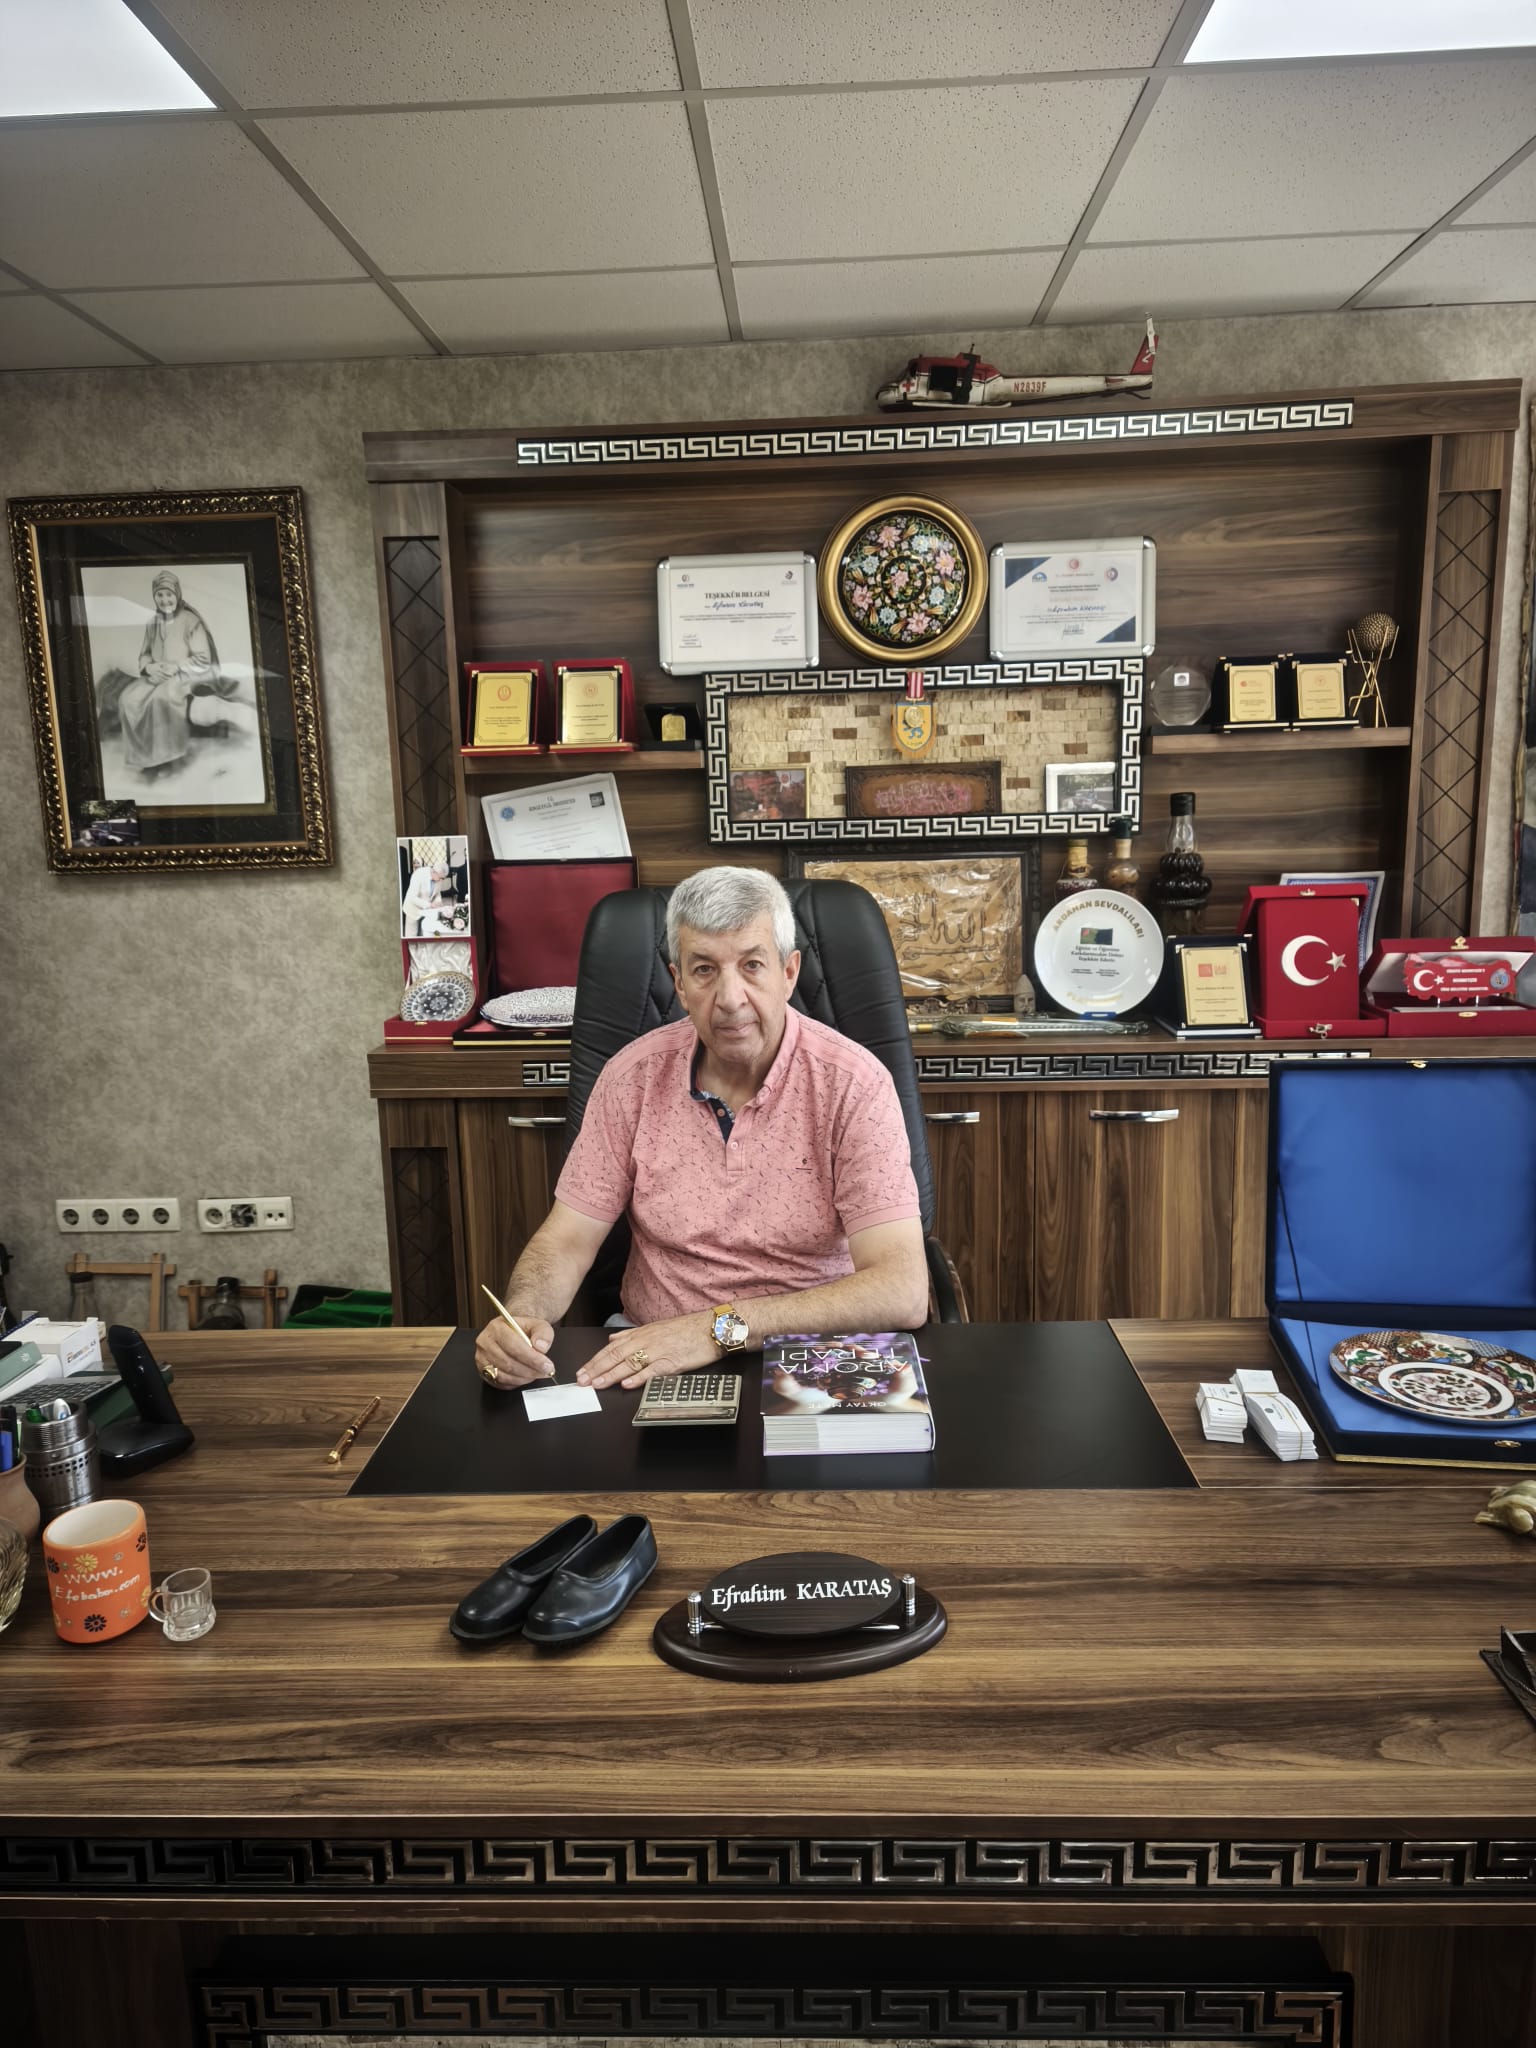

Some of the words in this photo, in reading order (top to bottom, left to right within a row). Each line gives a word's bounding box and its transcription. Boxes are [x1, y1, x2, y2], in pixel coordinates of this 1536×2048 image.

[778, 1360, 909, 1375] AROMA
[711, 1583, 787, 1612] Efrahim
[796, 1577, 892, 1600] KARATAŞ
